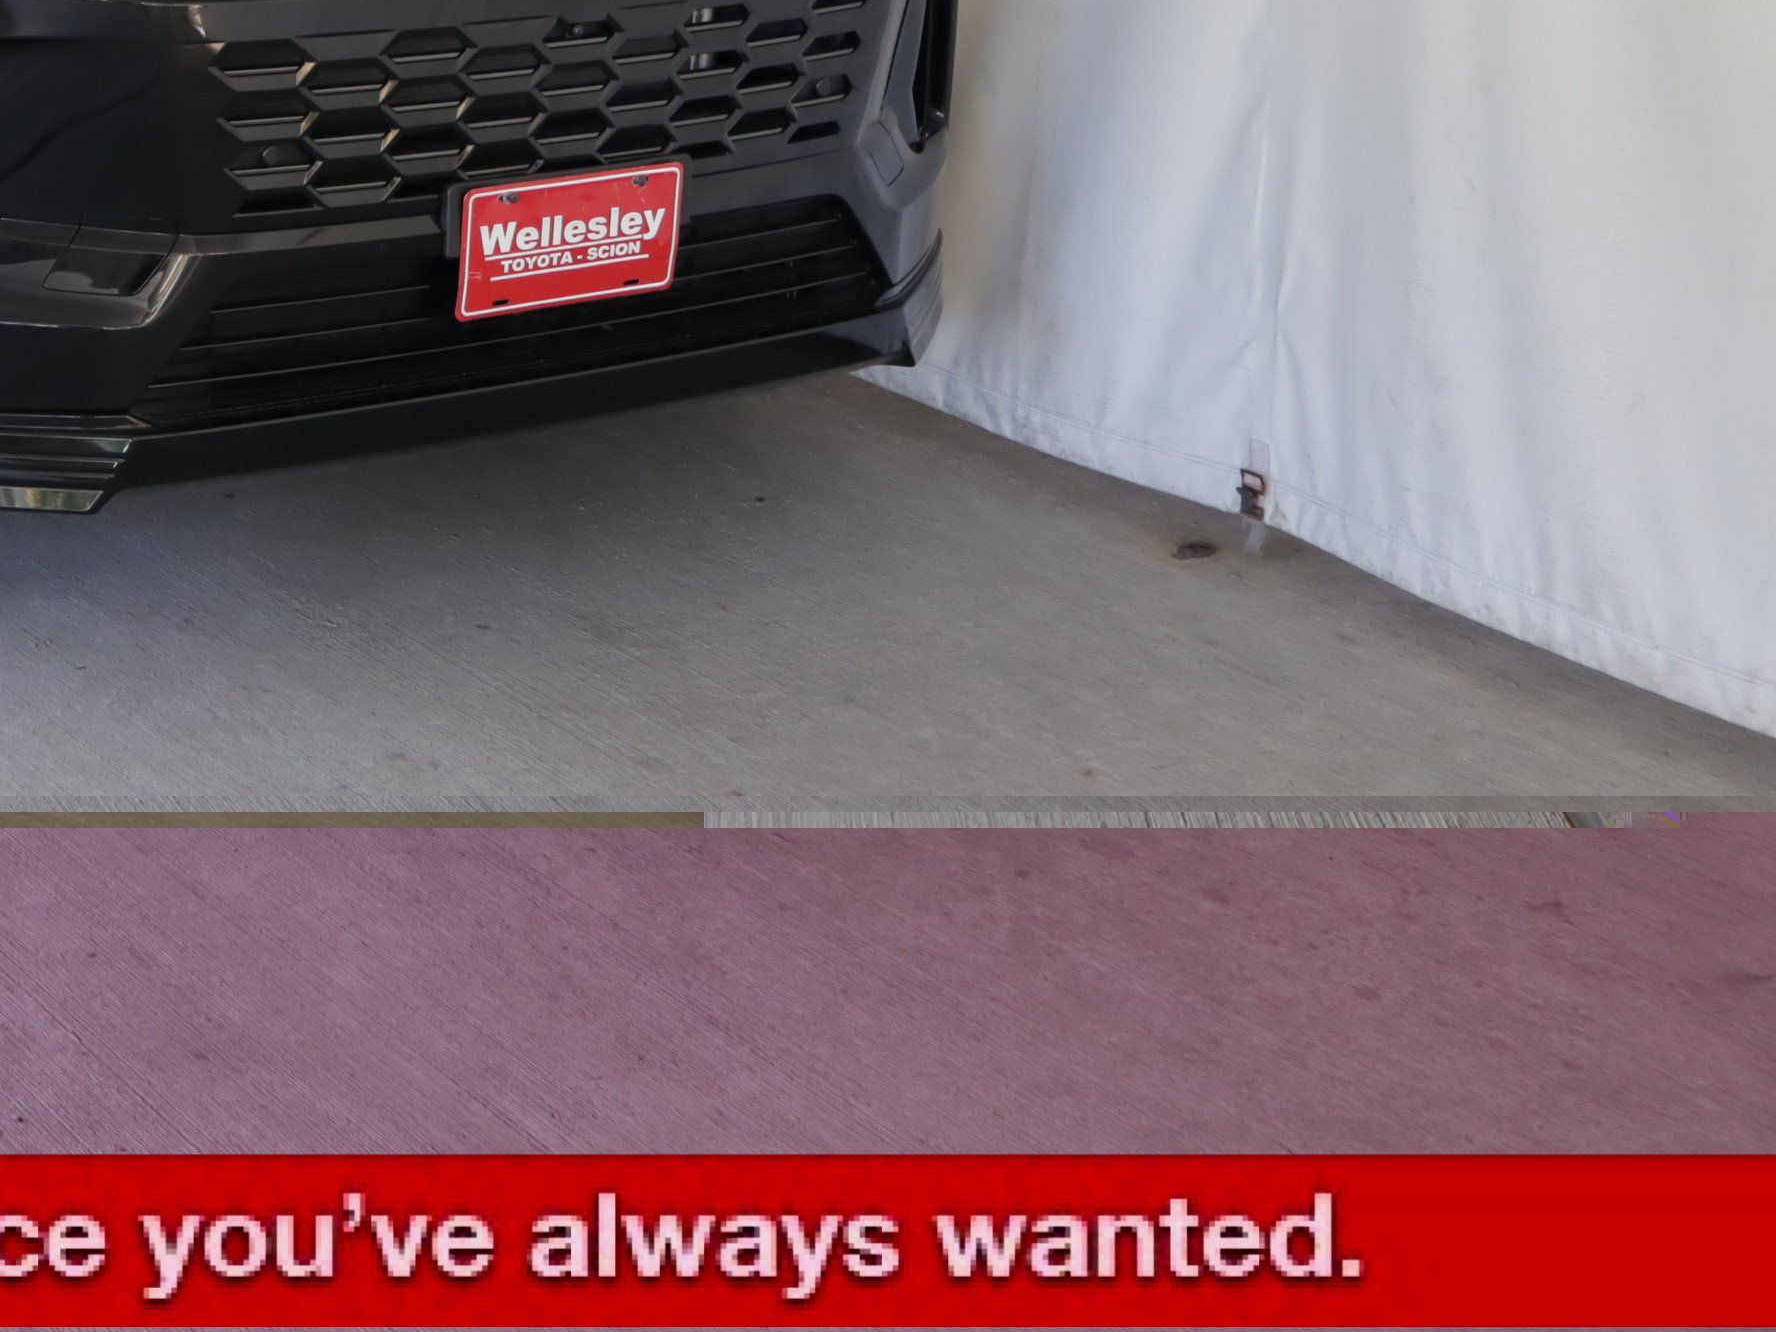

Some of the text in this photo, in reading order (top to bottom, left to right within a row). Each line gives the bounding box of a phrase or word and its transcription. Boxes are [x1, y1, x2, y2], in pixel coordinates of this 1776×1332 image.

[480, 207, 666, 256] Wellesley
[500, 252, 574, 274] TOYOTA
[586, 240, 642, 262] SCION
